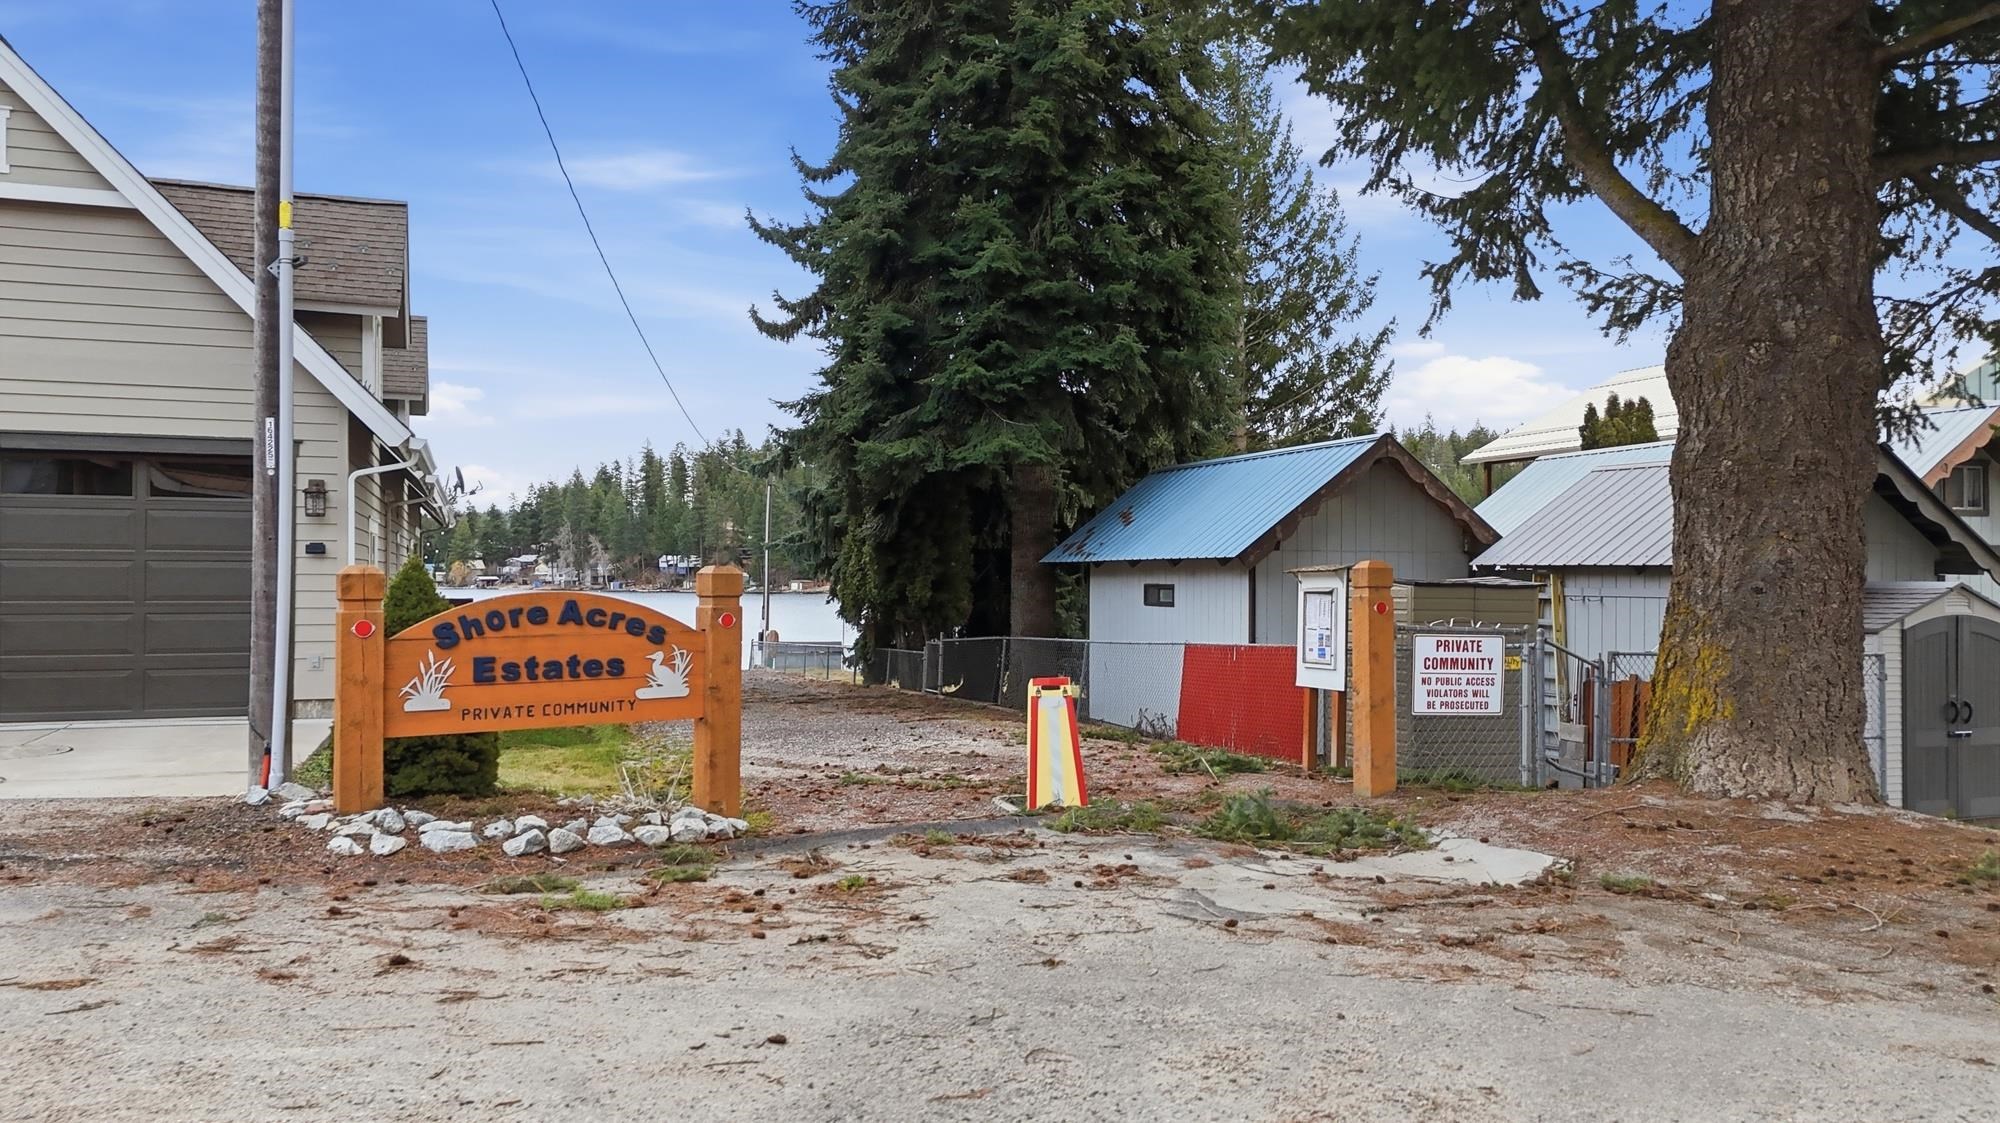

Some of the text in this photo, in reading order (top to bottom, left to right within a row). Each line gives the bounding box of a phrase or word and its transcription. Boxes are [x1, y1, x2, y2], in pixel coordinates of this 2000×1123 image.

[432, 599, 667, 650] Shore Acres
[1436, 640, 1482, 652] PRIVATE
[473, 655, 625, 683] Estates
[1423, 657, 1494, 670] COMMUNITY
[1421, 677, 1496, 686] NO PUBLIC ACCESS
[1426, 689, 1490, 698] VIOLATORS WILL
[462, 699, 637, 721] PRIVATE COMMUNITY
[1426, 700, 1489, 710] BE PROSECUTED
